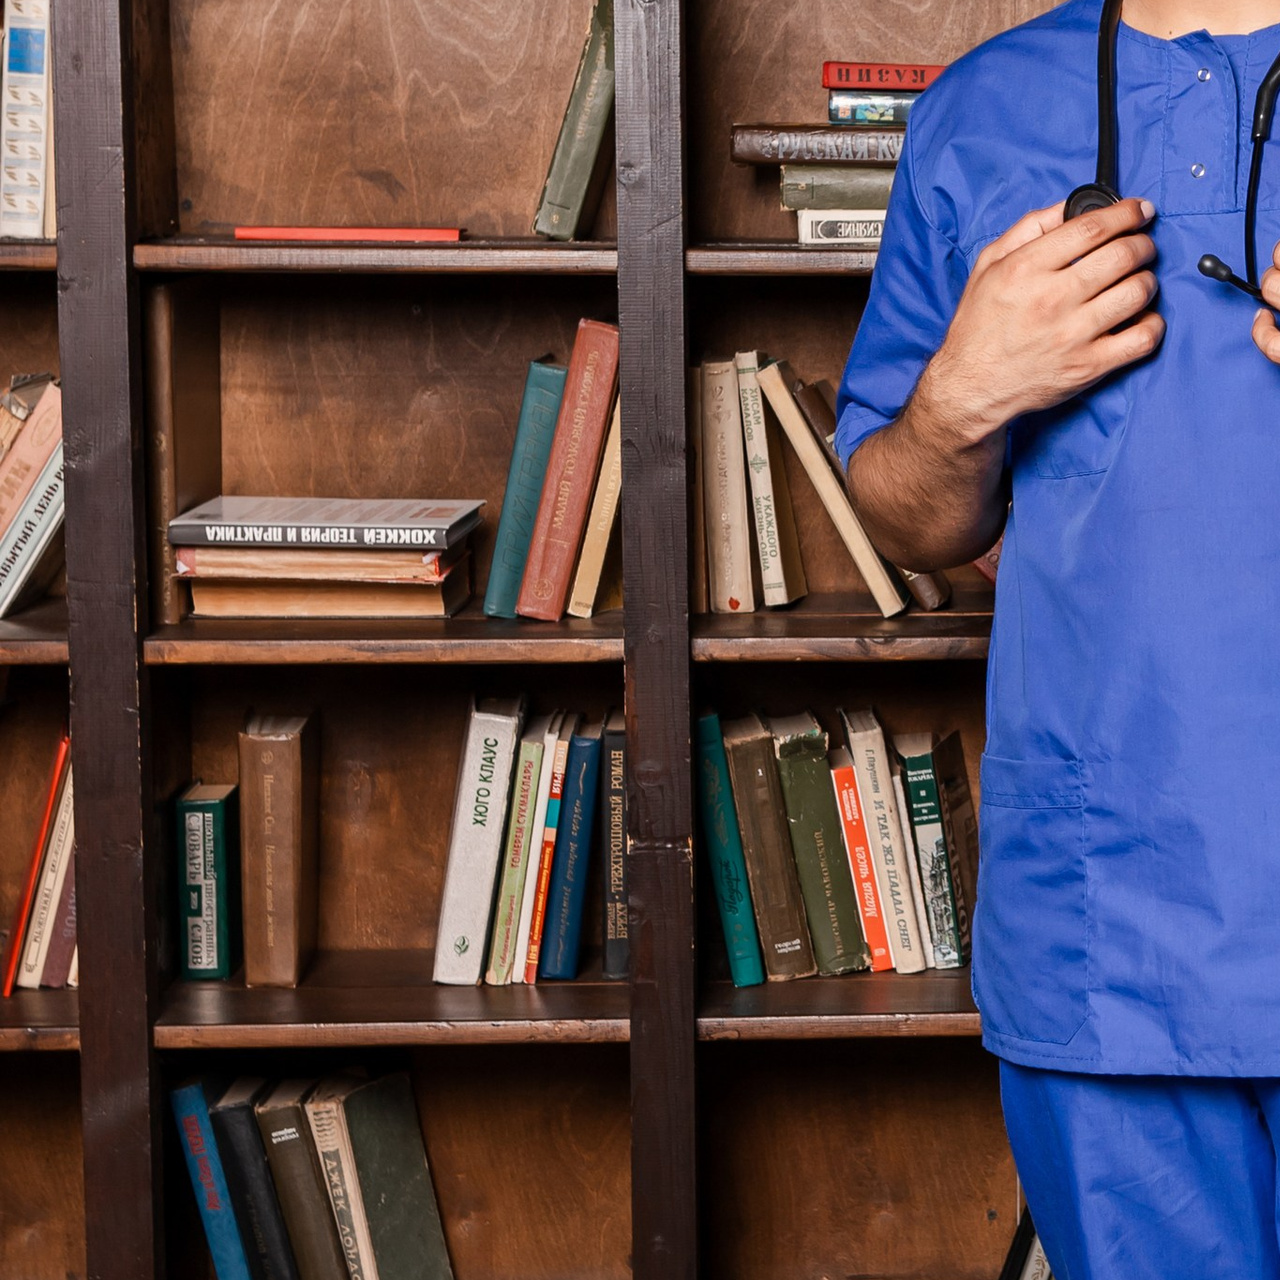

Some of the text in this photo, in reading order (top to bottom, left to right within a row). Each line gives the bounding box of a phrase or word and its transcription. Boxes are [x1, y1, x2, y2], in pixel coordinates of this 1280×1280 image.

[836, 66, 926, 84] КАЗИН
[775, 130, 869, 162] РУССКАЯ
[836, 221, 882, 238] СИЯНИЕ
[740, 387, 754, 441] КАМАЛОВ
[749, 386, 762, 426] ХИСАМ
[551, 349, 599, 530] МАЛЫЙ ТОЛКОВЫЙ СЛОВАРЬ
[0, 479, 60, 588] АБЫТЫЙ ДЕНЬ
[204, 524, 435, 545] ХОККЕЙ ТЕОРИЯ И ПРАКТИКА
[763, 503, 779, 558] КАЖДОГО
[471, 736, 499, 827] ХЮГО КЛАУС
[872, 798, 885, 811] И
[185, 813, 203, 880] СЛОВАРЬ
[609, 749, 628, 938] БРЕХТ ТРЕХГРОШОВЫЙ РОМАН
[875, 813, 890, 841] ТАК
[852, 844, 878, 919] Магия чисел
[881, 842, 895, 867] ЖЕ
[811, 830, 846, 960] ЛЕКСАНДР ЧАКОВСКИЙ
[203, 882, 215, 966] иностранных
[895, 917, 912, 952] СНЕГ
[324, 1155, 347, 1212] ДЖЕК
